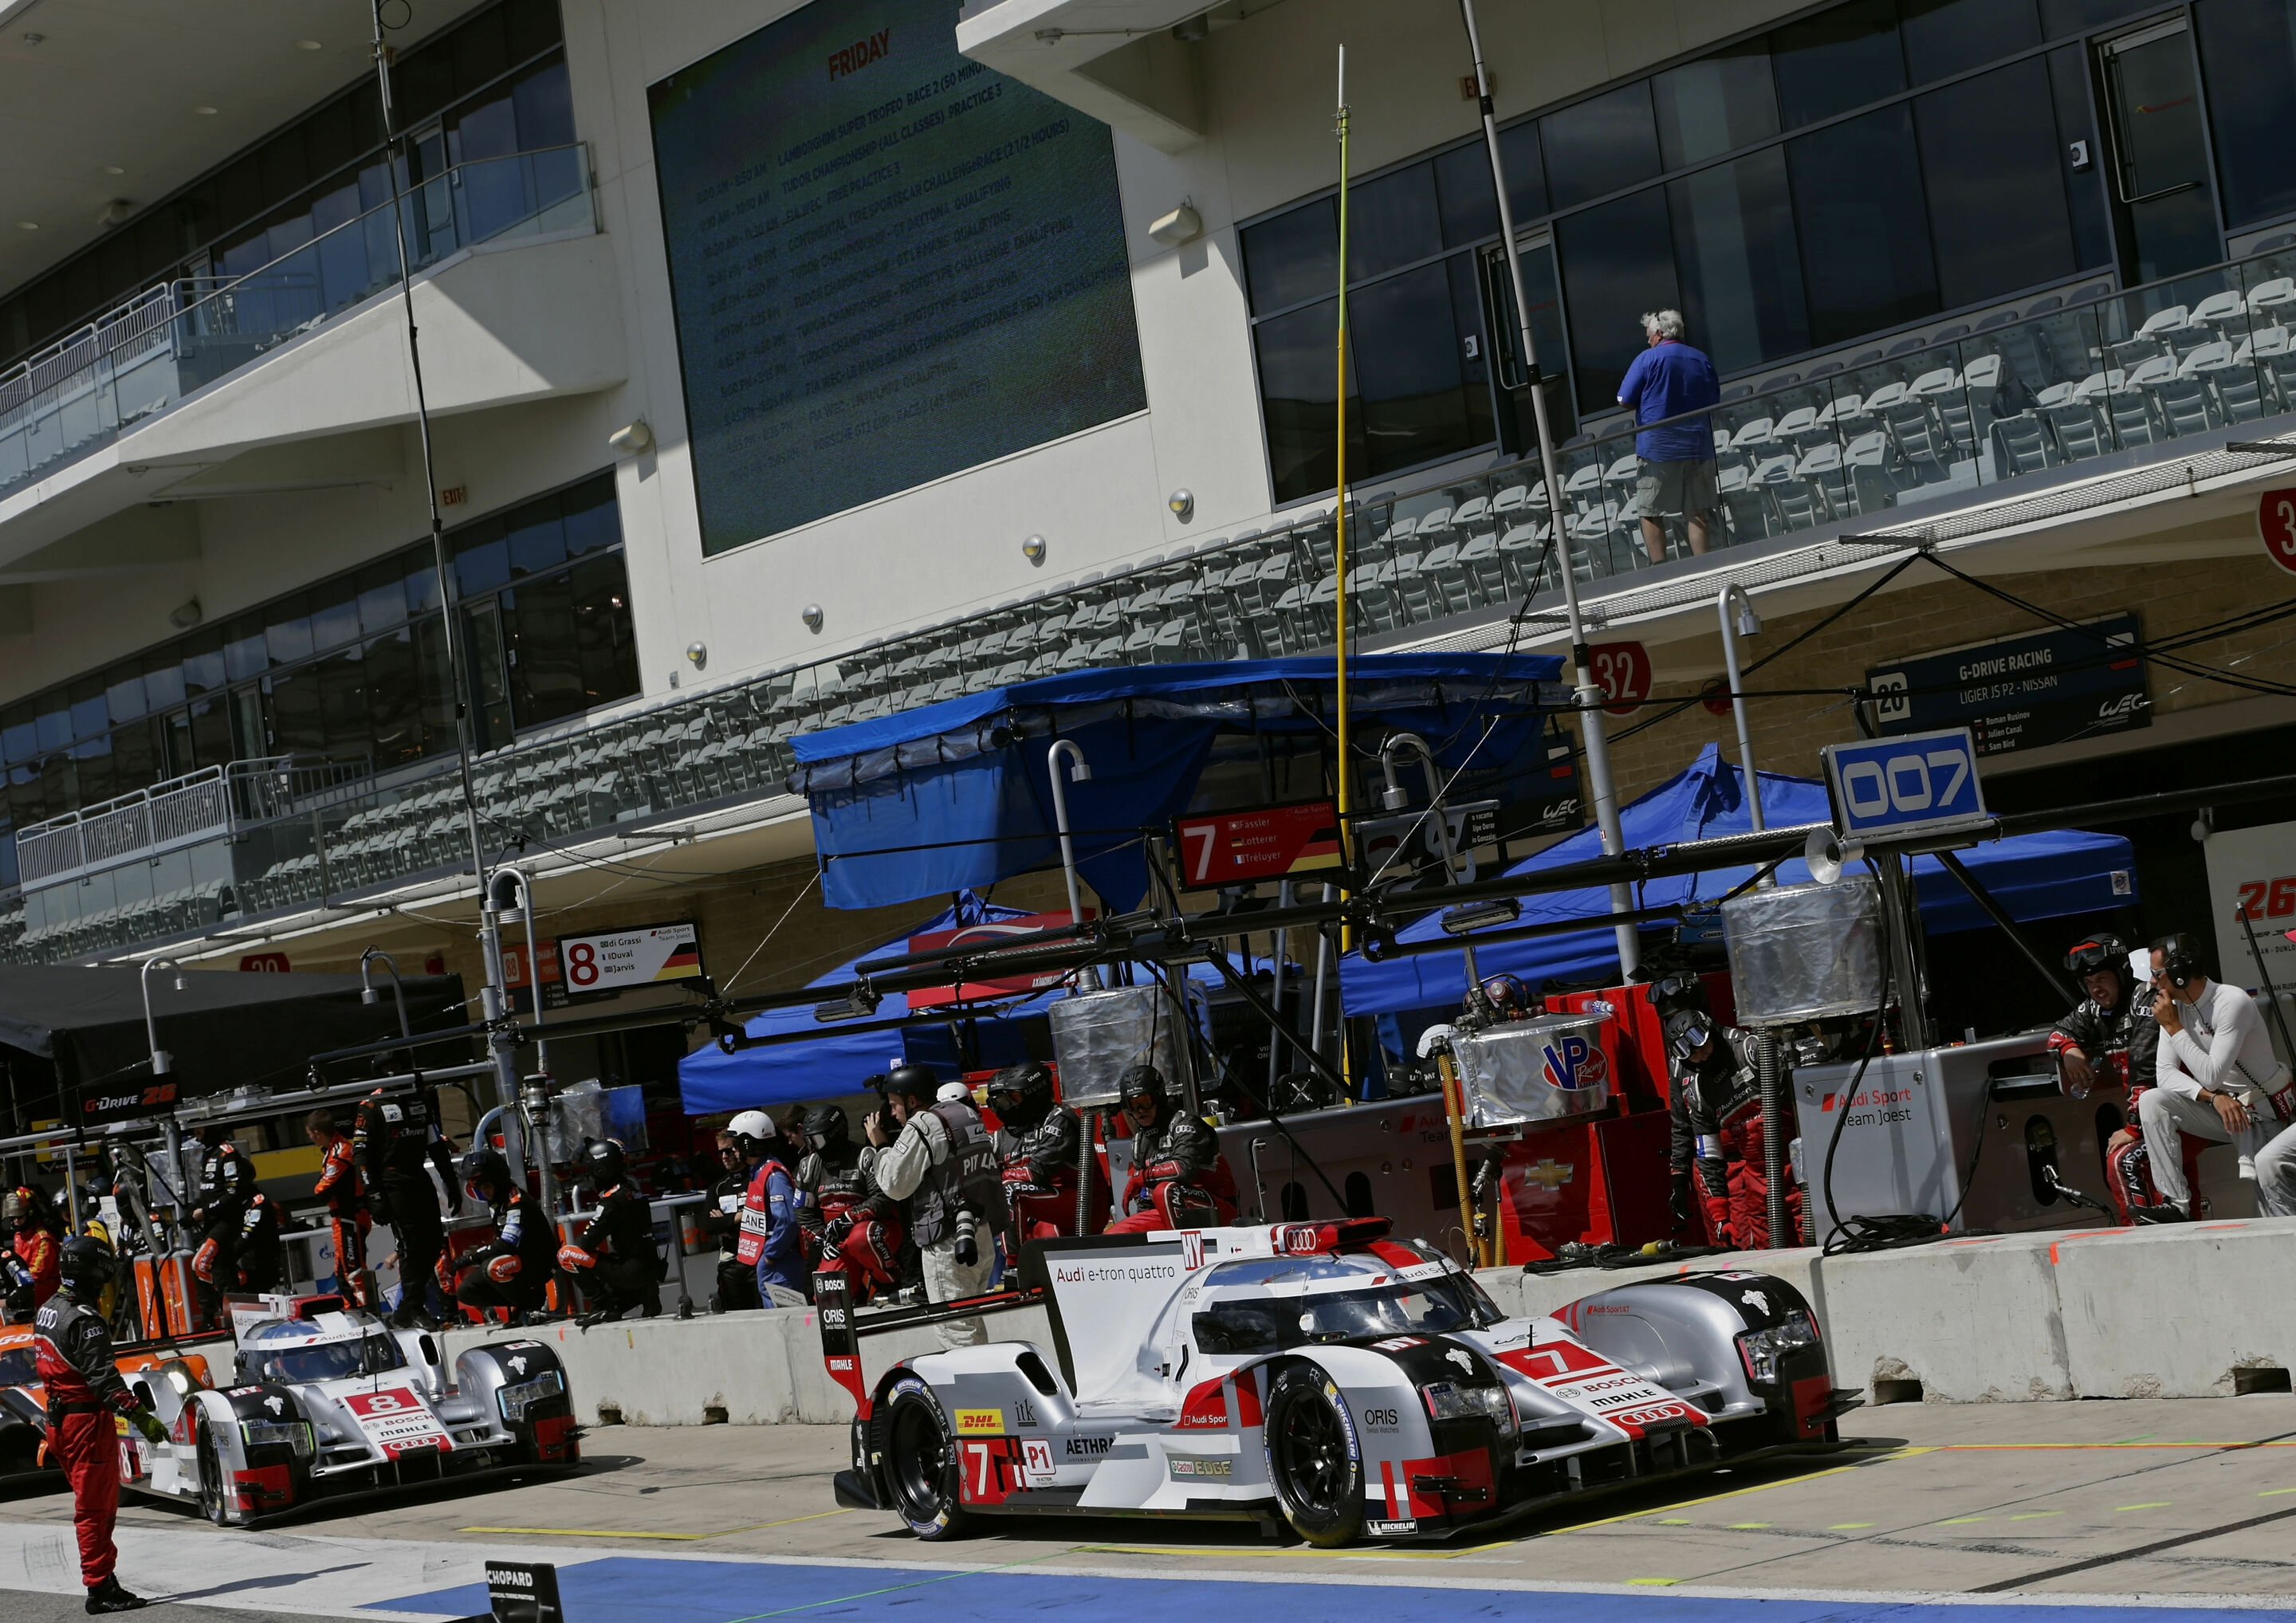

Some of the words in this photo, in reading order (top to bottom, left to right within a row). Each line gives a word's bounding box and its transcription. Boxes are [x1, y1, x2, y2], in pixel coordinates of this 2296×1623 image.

[827, 27, 892, 83] FRIDAY
[777, 128, 837, 167] LAMBORGHINI
[838, 114, 866, 140] SUPER
[867, 96, 903, 126] TROFEO
[906, 83, 932, 108] RACE
[932, 80, 939, 96] 2
[812, 140, 878, 182] CHAMPIONSHIP
[879, 129, 901, 152] (ALL
[902, 109, 945, 142] CLASSES)
[948, 86, 994, 120] PRACTICE
[994, 82, 1002, 100] 3
[1031, 117, 1070, 147] HOURS)
[826, 183, 848, 206] FREE
[849, 163, 893, 195] PRACTICE
[893, 161, 900, 175] 3
[953, 175, 1012, 213] QUALIFYING
[442, 487, 461, 505] EXIT
[1960, 656, 2007, 681] G-DRIVE
[2008, 648, 2053, 671] RACING
[1597, 651, 1637, 700] 32
[1877, 682, 1904, 714] 26
[1960, 686, 1989, 705] LIGIER
[1991, 684, 2001, 701] JS
[2003, 682, 2015, 697] P2
[2023, 675, 2058, 694] NISSAN
[1987, 726, 2007, 739] Julien
[2007, 724, 2023, 736] Canal
[1988, 741, 2003, 752] Sam
[2003, 738, 2015, 749] Bird
[1842, 749, 1968, 819] 007
[1241, 835, 1277, 847] Lotterer
[1183, 824, 1217, 881] 7
[2235, 875, 2296, 923] 26
[674, 925, 690, 934] Sport
[618, 937, 642, 947] Grassi
[569, 943, 599, 985] 8
[611, 951, 634, 961] Duval
[505, 957, 517, 978] 88
[613, 963, 635, 974] Jarvis
[1543, 1036, 1589, 1091] VP
[1577, 1059, 1606, 1082] Racing
[141, 1083, 177, 1106] 26
[1734, 1085, 1753, 1102] Sport
[1872, 1087, 1913, 1106] Sport
[1877, 1107, 1913, 1126] Joest
[963, 1153, 979, 1176] PIT
[1181, 1233, 1205, 1268] HY
[1057, 1267, 1085, 1283] Audi
[1088, 1267, 1125, 1282] e-tron
[1129, 1265, 1175, 1283] quattro
[1394, 1270, 1428, 1282] Audi
[824, 1279, 845, 1291] BOSCH
[1184, 1287, 1200, 1300] ORIS
[824, 1308, 845, 1324] ORIS
[1593, 1305, 1606, 1314] Audi
[320, 1333, 346, 1342] Audi
[1372, 1336, 1422, 1352] HY
[830, 1359, 853, 1371] MAHLE
[1523, 1350, 1569, 1374] 7
[896, 1379, 922, 1391] MICHELIN
[1582, 1376, 1649, 1393] BOSCH
[368, 1395, 403, 1413] 8
[1590, 1389, 1657, 1408] MAHLE
[1015, 1398, 1036, 1422] itk
[1365, 1409, 1398, 1426] ORIS
[384, 1414, 435, 1427] BOSCH
[963, 1415, 997, 1428] DHL
[1191, 1415, 1208, 1425] Audi
[379, 1424, 431, 1437] MAHLE
[1335, 1403, 1356, 1459] MICHELIN
[1379, 1425, 1400, 1434] Watches
[120, 1441, 132, 1480] 8
[1028, 1446, 1051, 1470] P1
[967, 1443, 989, 1496] 7
[1176, 1461, 1195, 1474] Castrol
[1195, 1460, 1233, 1477] EDGE
[1380, 1521, 1416, 1531] MICHELIN
[487, 1570, 533, 1587] CHOPARD
